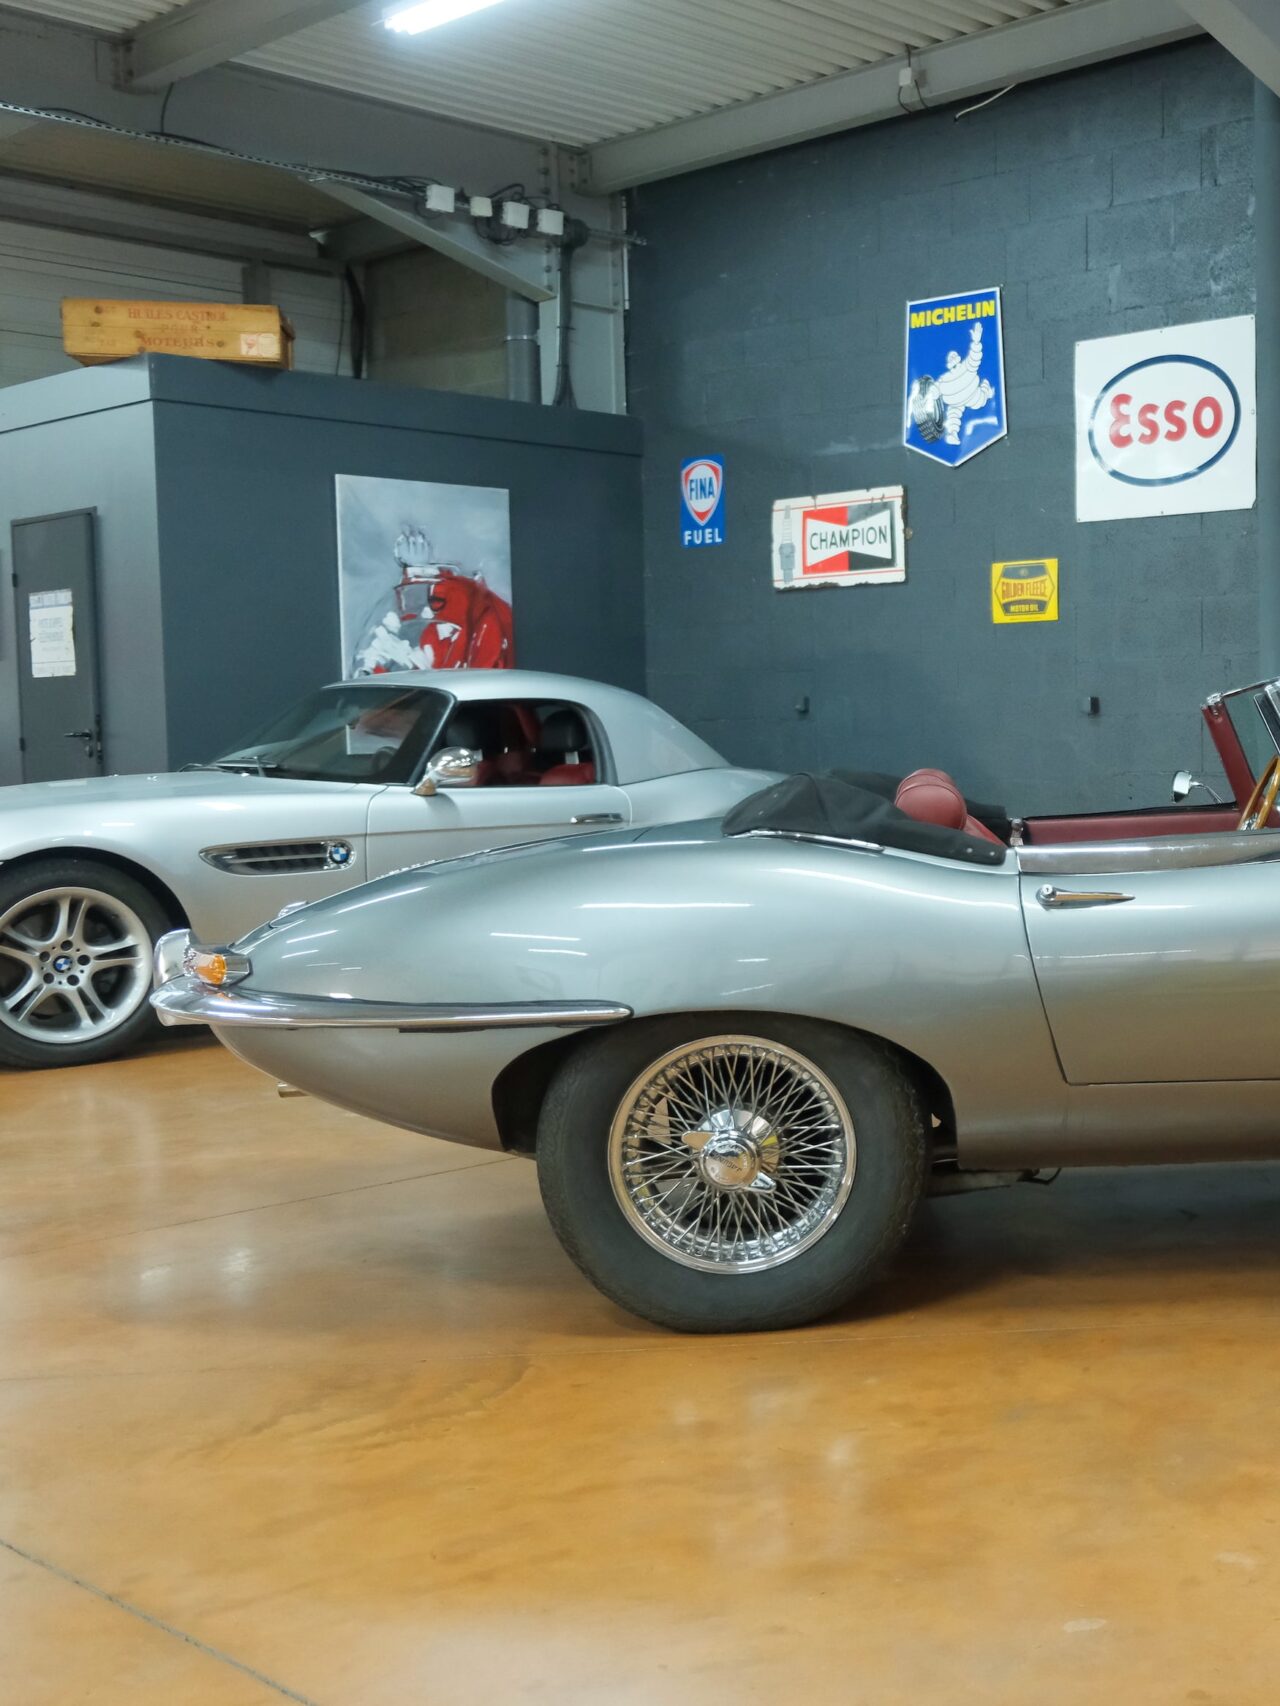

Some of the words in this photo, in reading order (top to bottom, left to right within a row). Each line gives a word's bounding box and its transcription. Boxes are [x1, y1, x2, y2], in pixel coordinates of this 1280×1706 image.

[910, 299, 995, 329] MICHELIN
[689, 476, 716, 501] FINA
[683, 527, 722, 546] FUEL
[809, 525, 888, 551] CHAMPION
